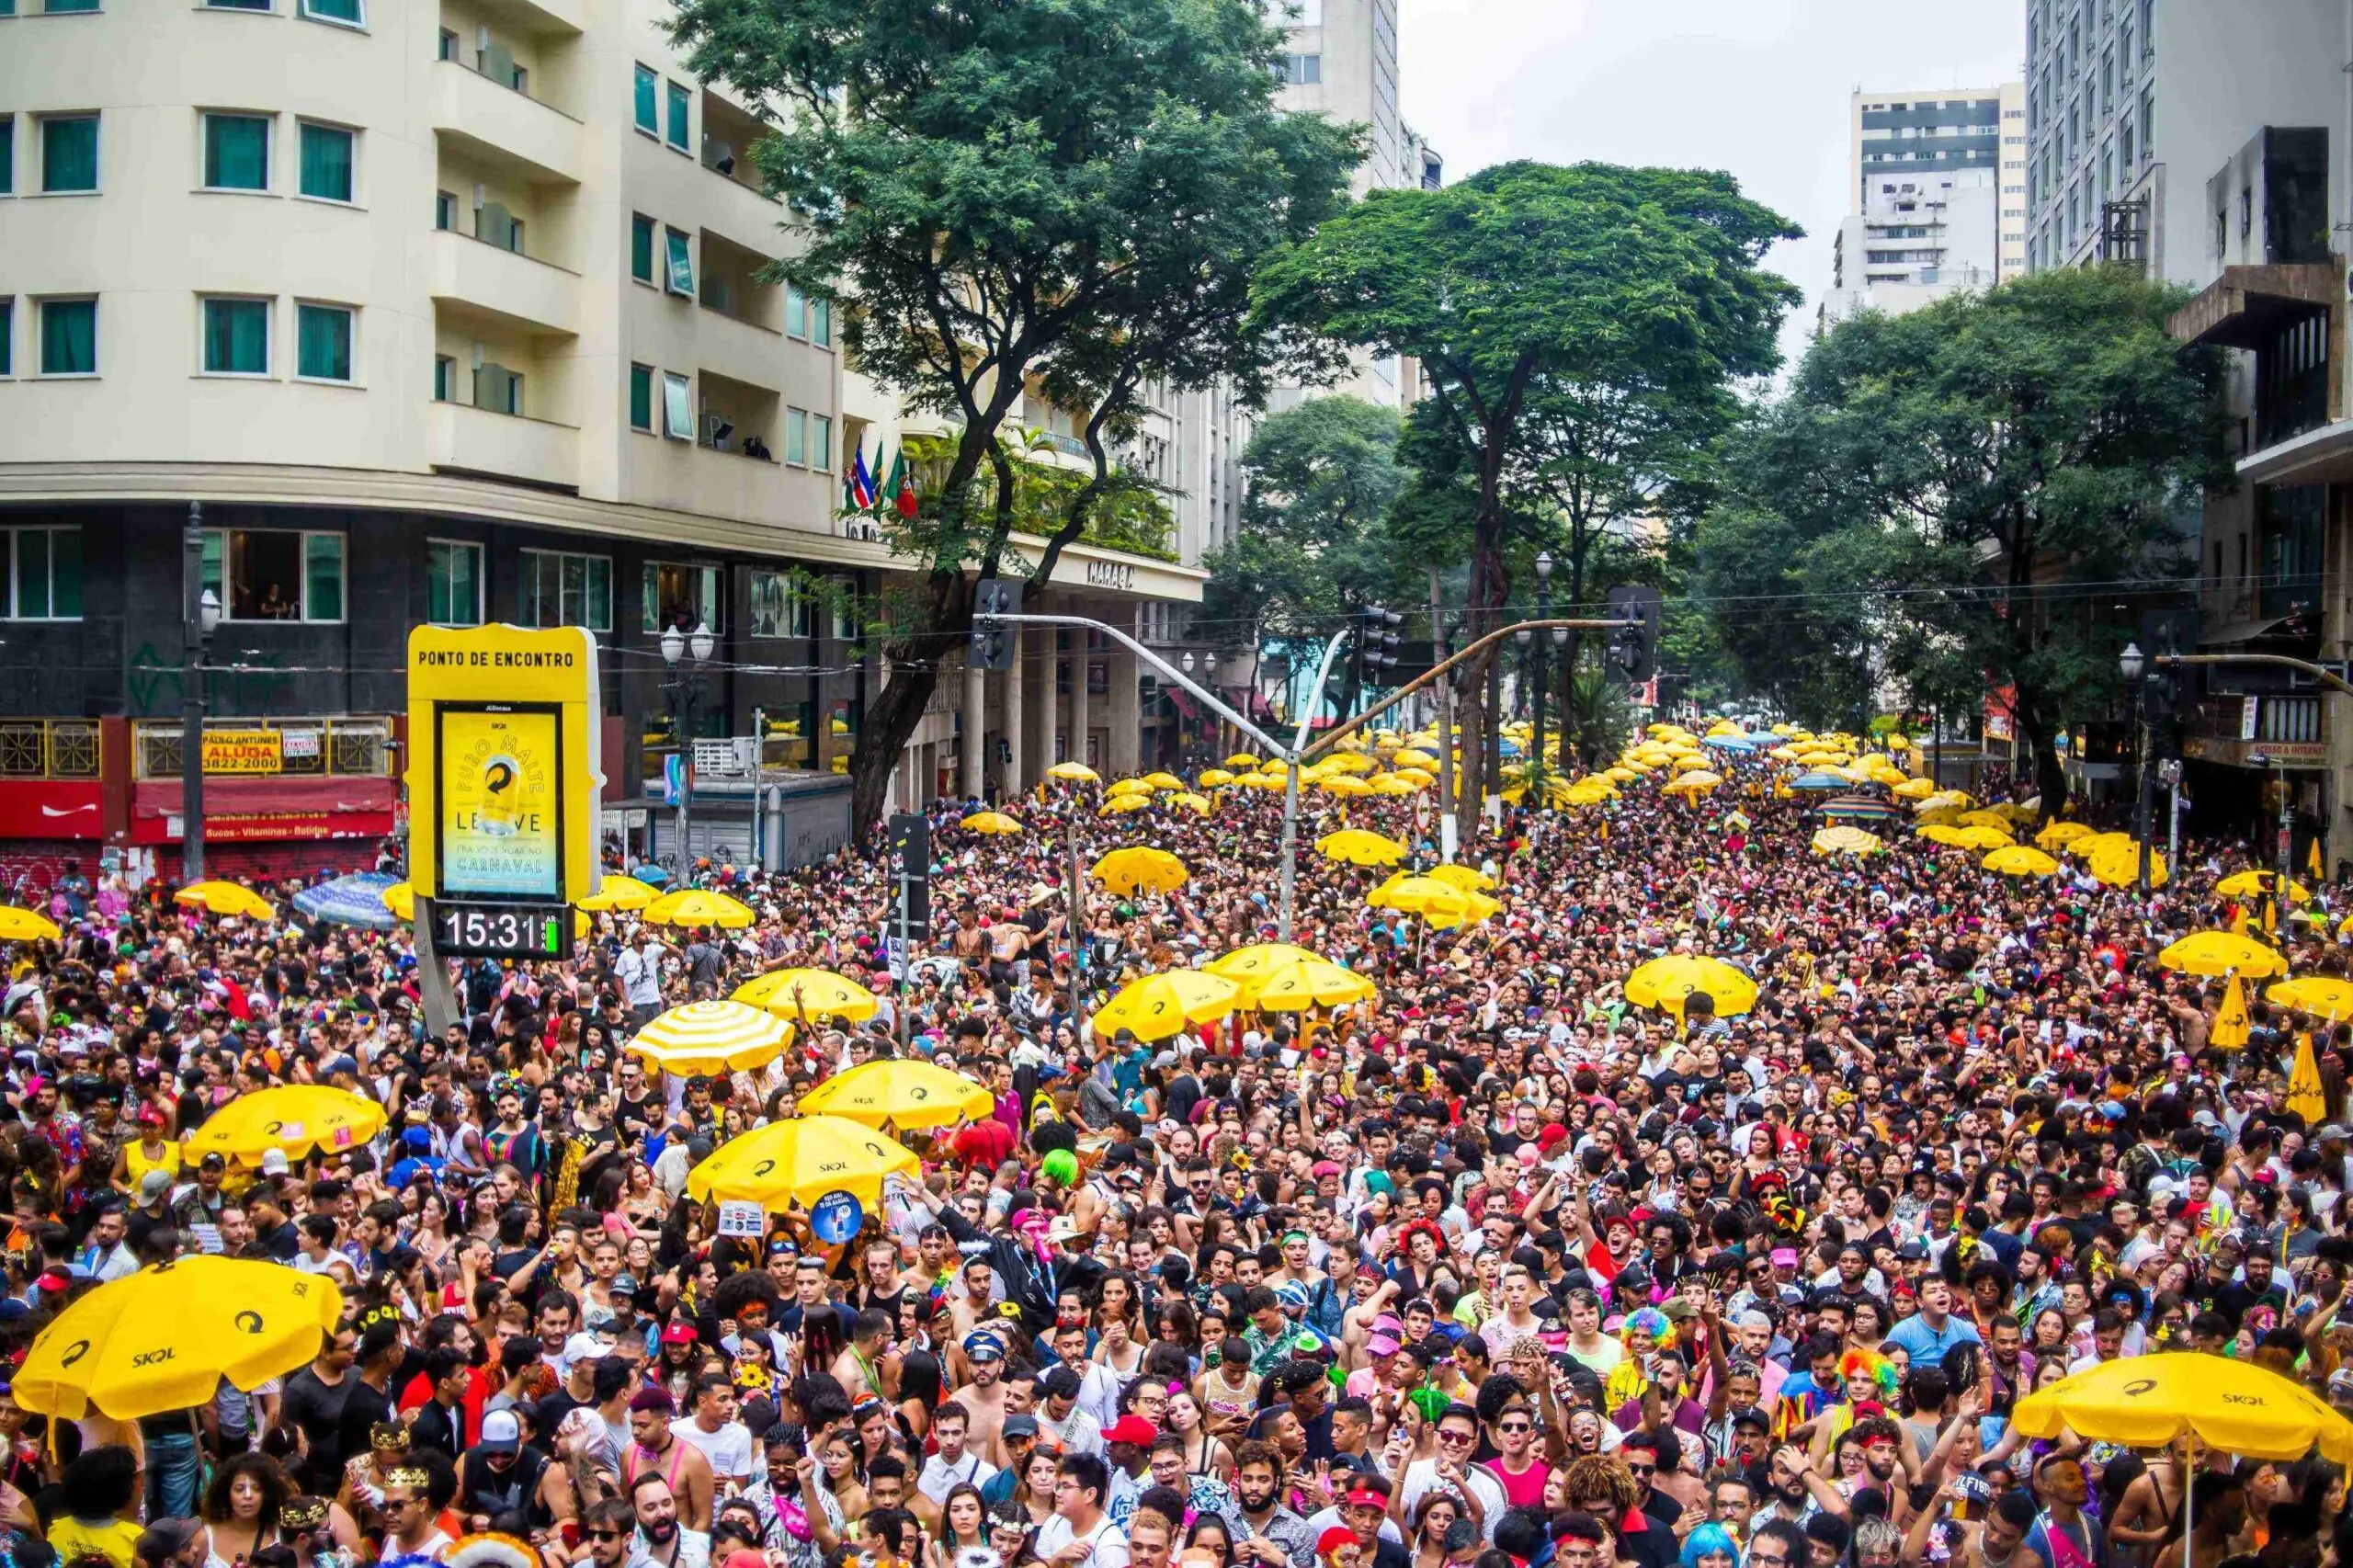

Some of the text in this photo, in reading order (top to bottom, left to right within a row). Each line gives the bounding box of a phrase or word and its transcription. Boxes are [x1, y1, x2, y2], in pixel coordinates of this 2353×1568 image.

[418, 651, 574, 667] PONTO DE ENCONTRO
[236, 735, 278, 745] ANTUNES
[209, 746, 275, 759] ALUGA
[203, 759, 278, 769] 3822-2000
[457, 734, 545, 794] PURO MALTE
[242, 826, 288, 836] Vitaminas
[457, 858, 542, 873] CARNAVAL
[447, 912, 534, 949] 15:31
[820, 1161, 849, 1173] SKOL
[131, 1346, 176, 1369] SKOL
[2222, 1393, 2268, 1407] SKOL
